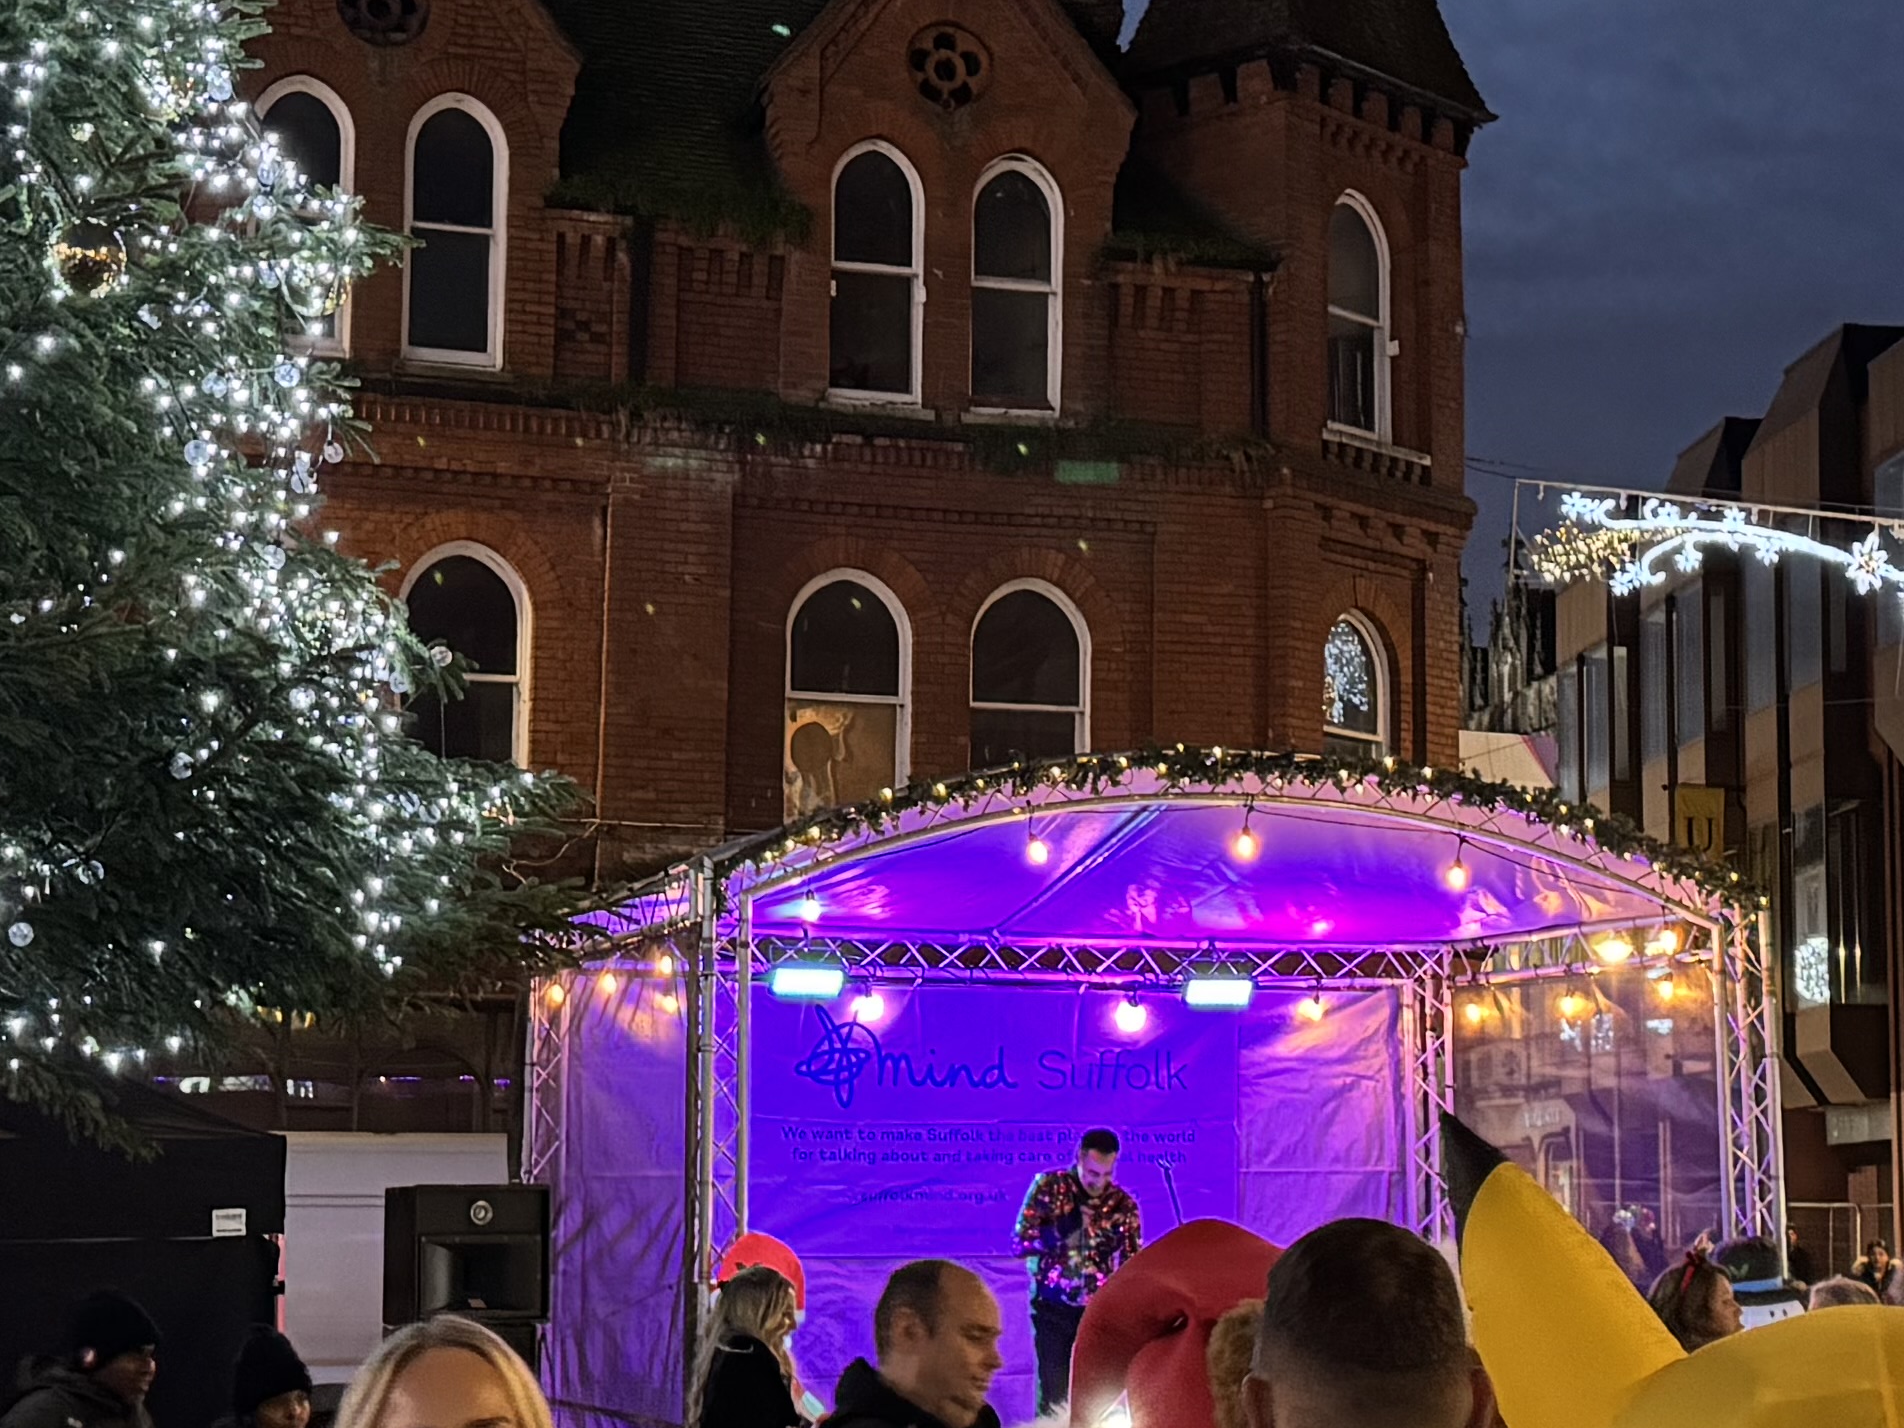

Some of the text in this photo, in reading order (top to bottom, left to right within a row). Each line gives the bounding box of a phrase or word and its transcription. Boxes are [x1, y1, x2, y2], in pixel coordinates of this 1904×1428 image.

[877, 1045, 1189, 1092] mind Suffolk
[781, 1125, 806, 1141] We
[811, 1127, 852, 1141] want
[857, 1127, 876, 1141] to
[880, 1127, 922, 1141] make
[926, 1127, 984, 1142] Suffolk
[1153, 1129, 1196, 1143] world
[792, 1147, 1072, 1164] for talking about and taking care of
